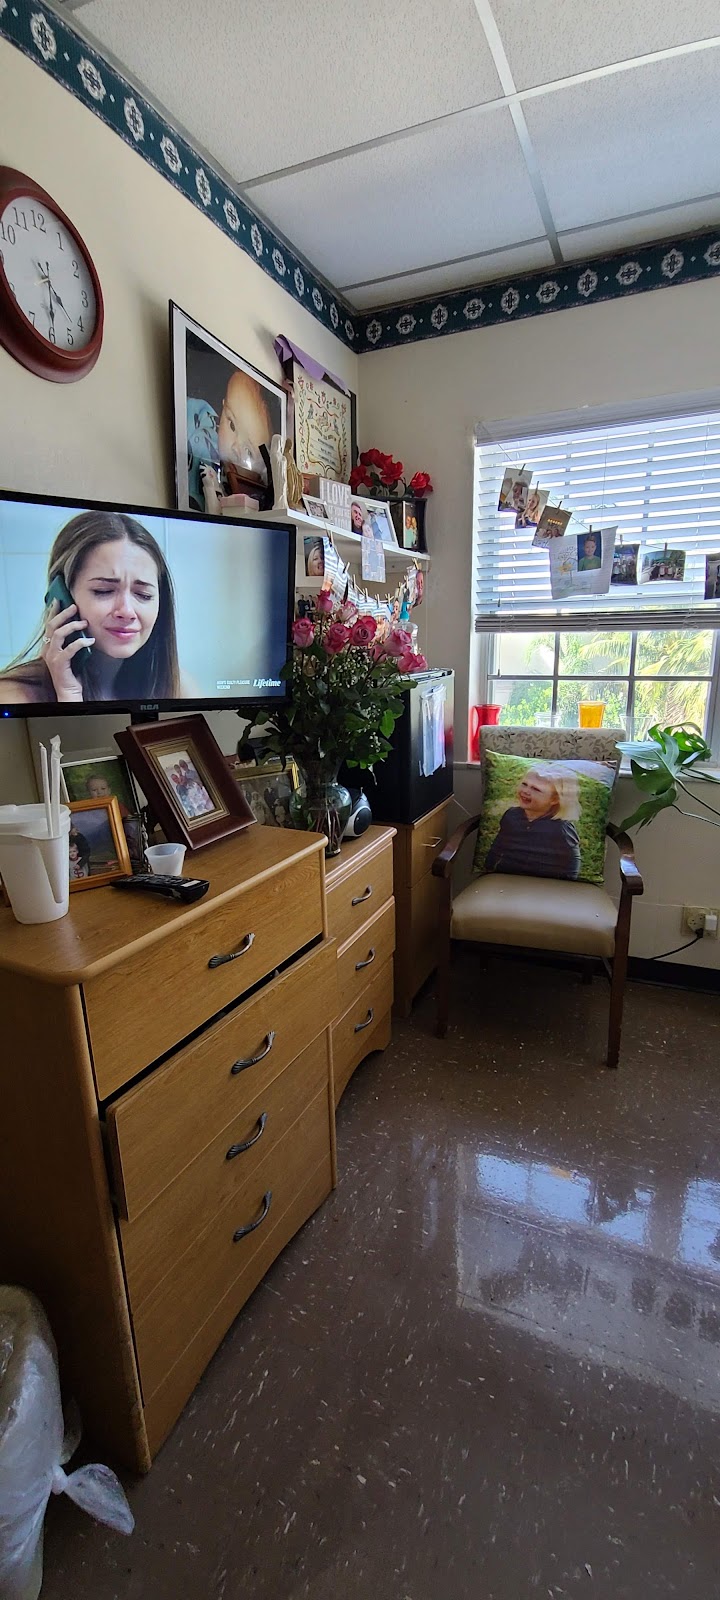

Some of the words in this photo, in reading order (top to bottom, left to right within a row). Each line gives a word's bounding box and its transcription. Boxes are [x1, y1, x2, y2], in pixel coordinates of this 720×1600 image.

[12, 206, 30, 232] 11
[30, 209, 47, 234] 12
[0, 220, 16, 246] 10
[56, 232, 64, 251] 1
[72, 260, 80, 279] 2
[81, 290, 89, 308] 3
[77, 315, 85, 332] 4
[48, 327, 56, 344] 6
[66, 327, 74, 345] 5
[326, 481, 351, 508] LOVE
[253, 678, 281, 689] Lifetime
